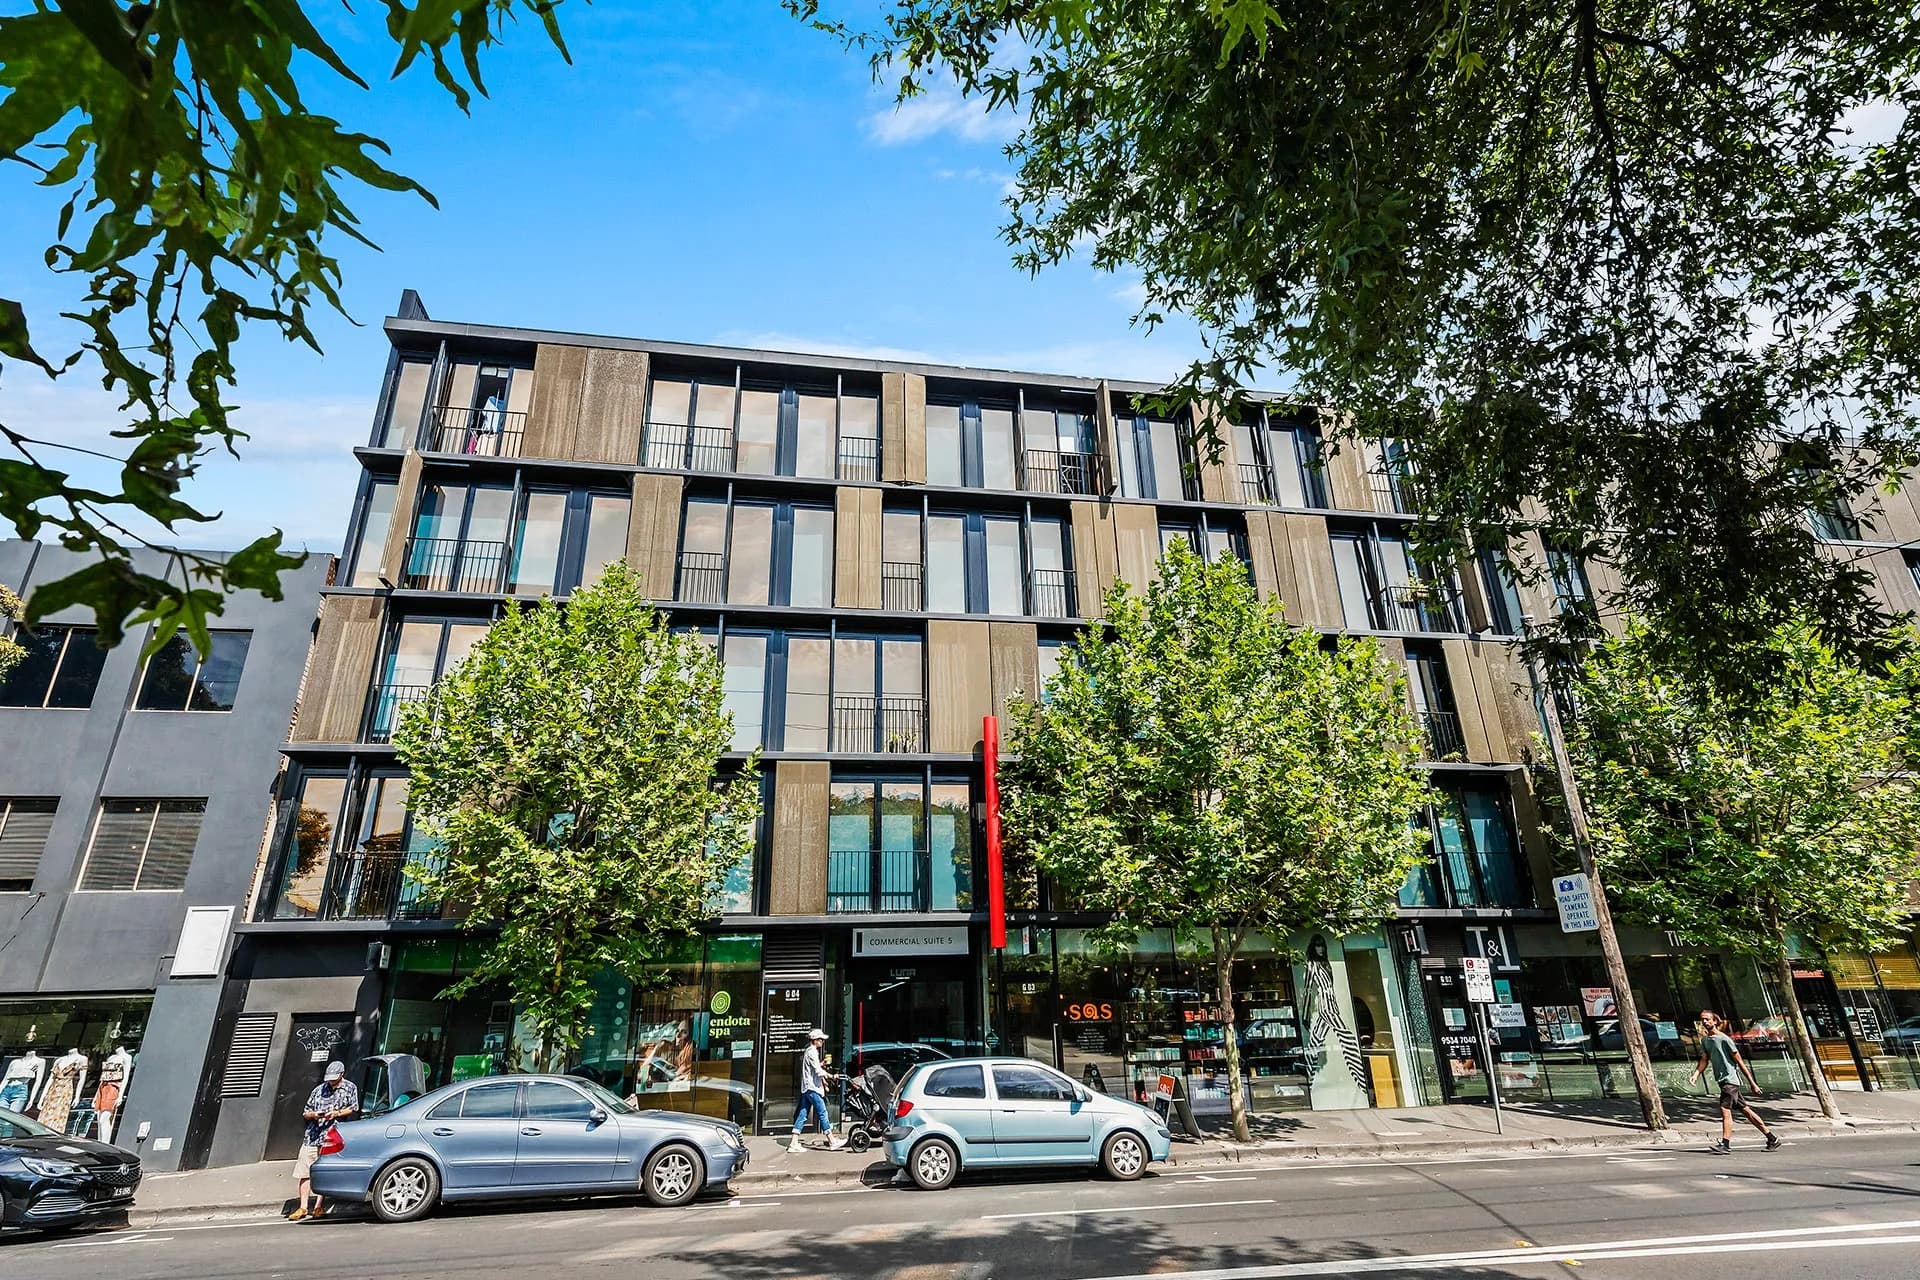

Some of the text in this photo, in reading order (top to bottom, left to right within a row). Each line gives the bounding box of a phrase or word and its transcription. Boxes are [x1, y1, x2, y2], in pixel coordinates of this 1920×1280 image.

[1572, 893, 1589, 901] SAFETY
[1564, 902, 1588, 911] CAMERAS
[1567, 911, 1590, 920] OPERATE
[1571, 920, 1582, 928] THIS
[1584, 919, 1597, 927] AREA
[869, 938, 921, 946] COMMERCIAL
[923, 937, 945, 945] SUITE
[890, 968, 916, 977] LUNA
[709, 1016, 751, 1027] endota
[709, 1027, 731, 1039] spa
[1441, 1036, 1477, 1045] 9534 7040
